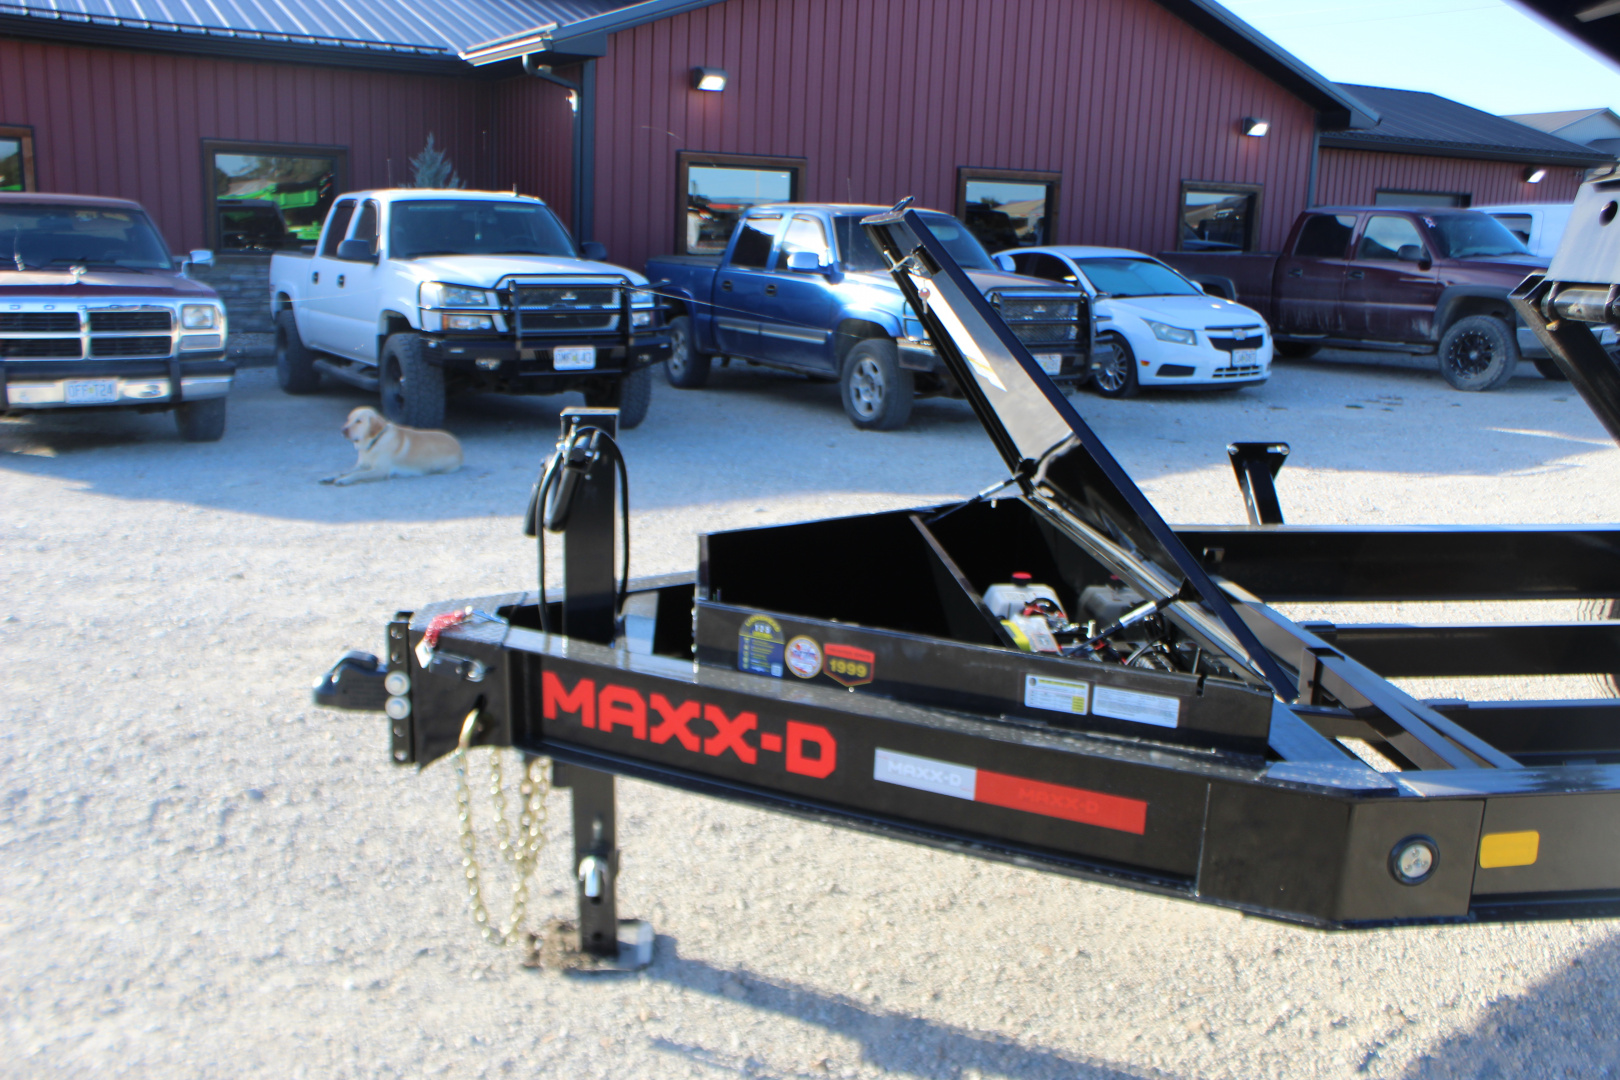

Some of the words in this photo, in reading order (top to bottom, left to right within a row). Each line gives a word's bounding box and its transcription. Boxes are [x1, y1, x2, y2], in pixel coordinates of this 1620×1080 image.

[830, 658, 867, 678] 1999
[542, 670, 837, 779] MAXX-D
[888, 761, 962, 787] MAXX-D
[1018, 787, 1099, 814] MAXX-D
